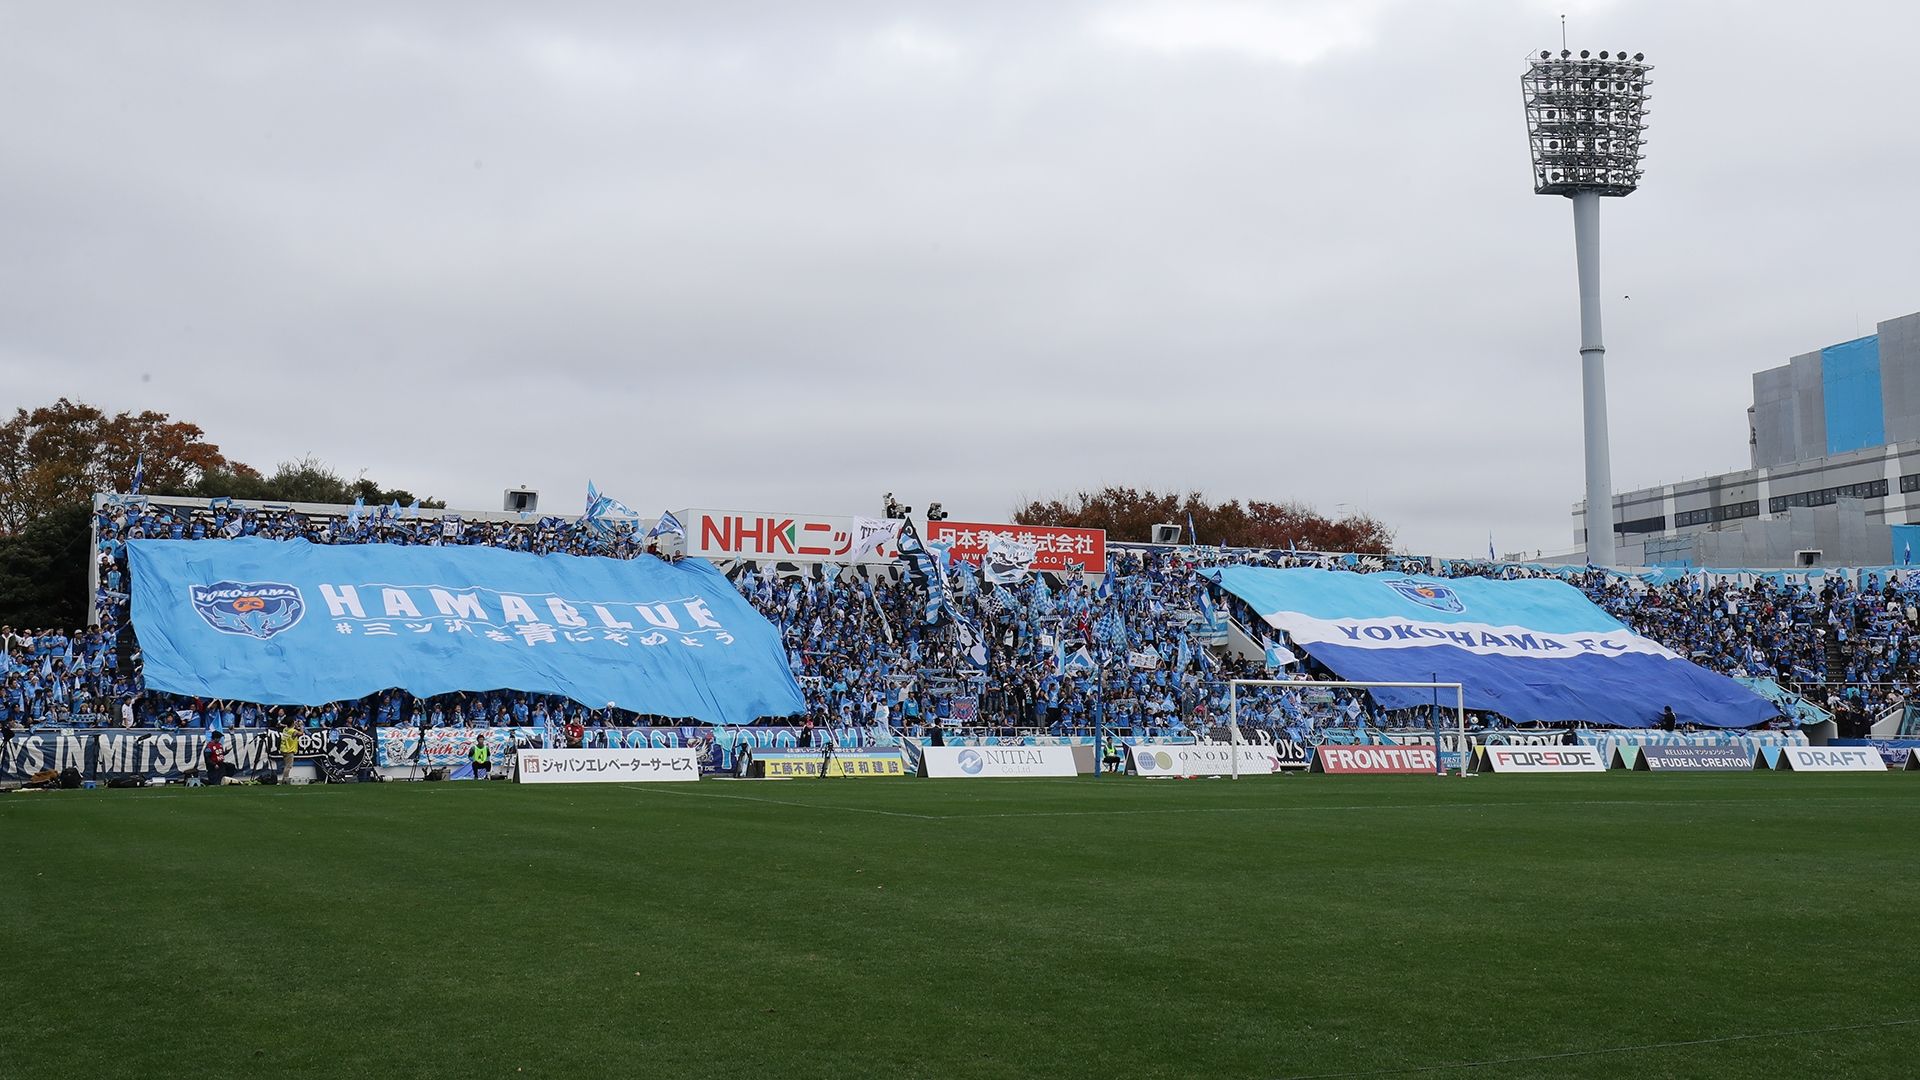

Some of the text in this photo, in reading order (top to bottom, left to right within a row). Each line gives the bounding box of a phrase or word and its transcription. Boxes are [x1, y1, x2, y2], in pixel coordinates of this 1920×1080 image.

[702, 515, 794, 554] NHK
[196, 588, 298, 602] YOKOHAMA
[318, 584, 722, 628] HAMABLUE
[1336, 624, 1628, 652] YOKOHAMA FC
[54, 735, 88, 775] IN
[986, 751, 1044, 765] NITTAI
[1179, 751, 1265, 761] ONODRA
[1324, 749, 1437, 769] FRONTIER
[1496, 752, 1595, 766] FORSIDE
[1797, 751, 1867, 766] DRAFT
[542, 757, 693, 773] ジャパンエレベーターサービス
[843, 761, 900, 774] 昭和建設
[1660, 758, 1752, 768] FUDEAL CREATION
